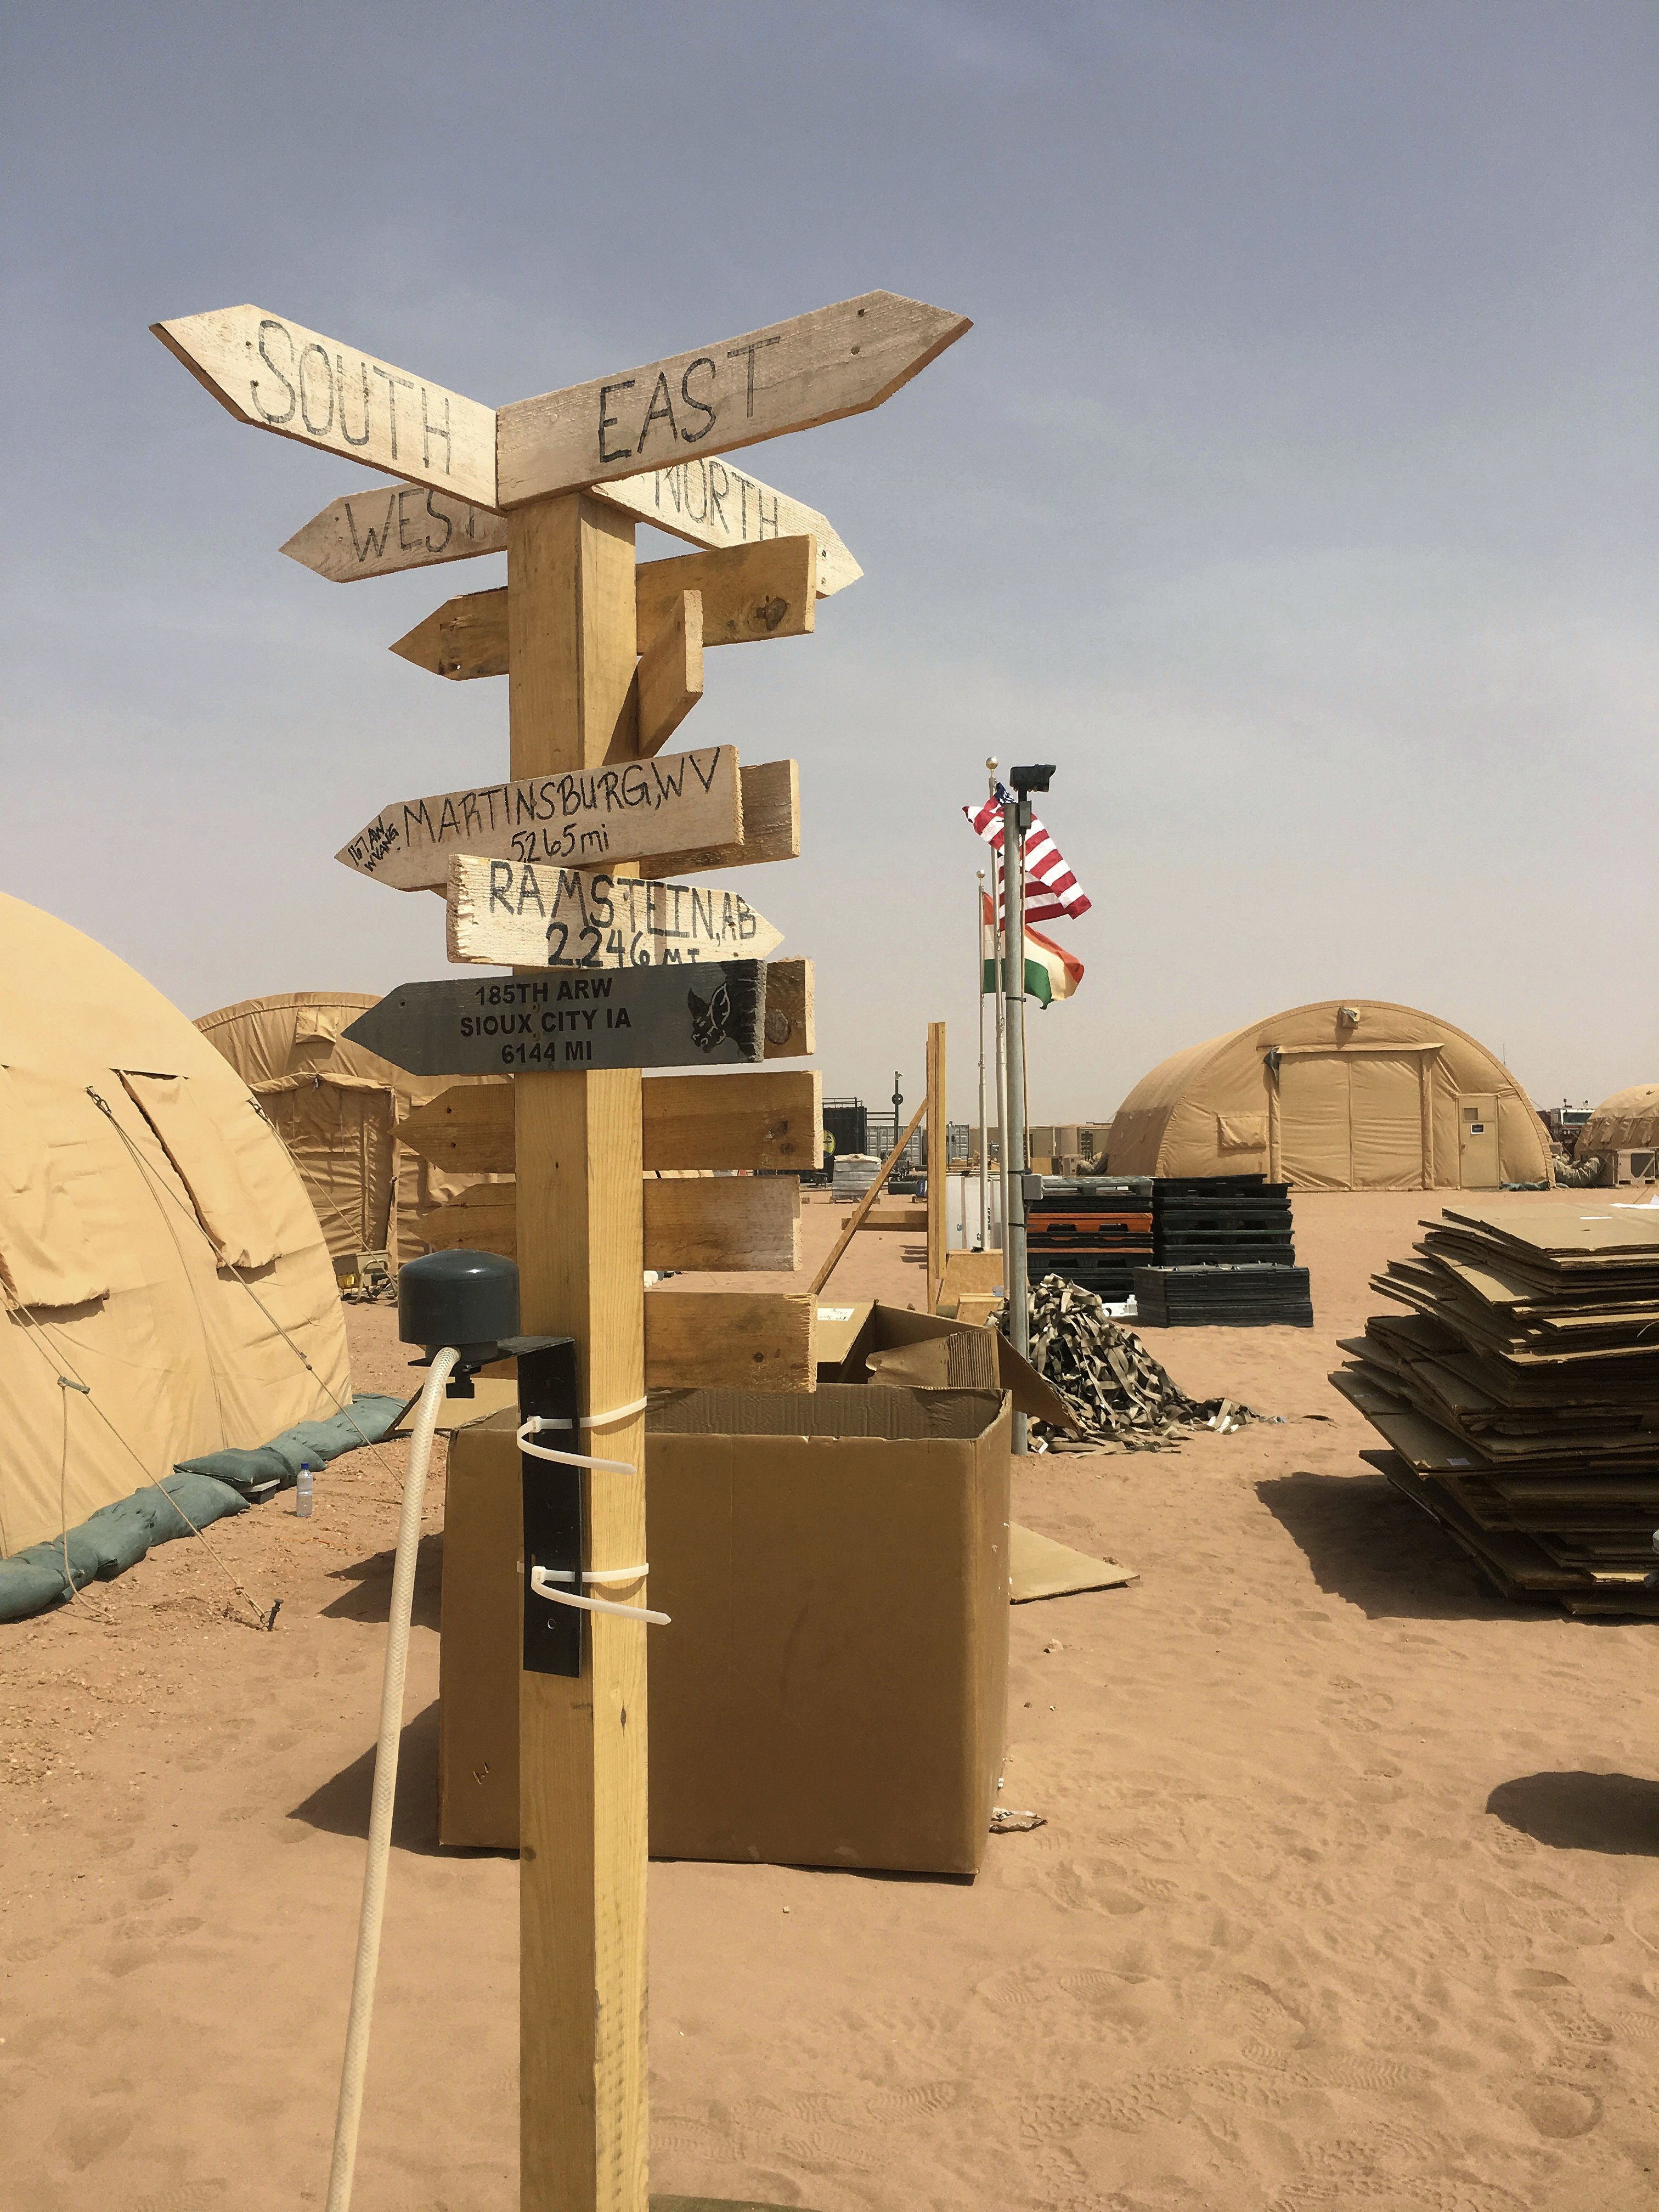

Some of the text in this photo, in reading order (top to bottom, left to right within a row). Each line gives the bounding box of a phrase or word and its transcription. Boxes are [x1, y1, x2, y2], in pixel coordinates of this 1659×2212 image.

[250, 319, 450, 475] SOUTH
[598, 336, 781, 463] EAST
[655, 458, 778, 541] NORTH
[546, 921, 700, 968] 2,246 MI
[476, 978, 613, 1006] 185TH ARW
[460, 1008, 631, 1037] SIOUX CITY IA
[501, 1041, 592, 1064] 6144 MI
